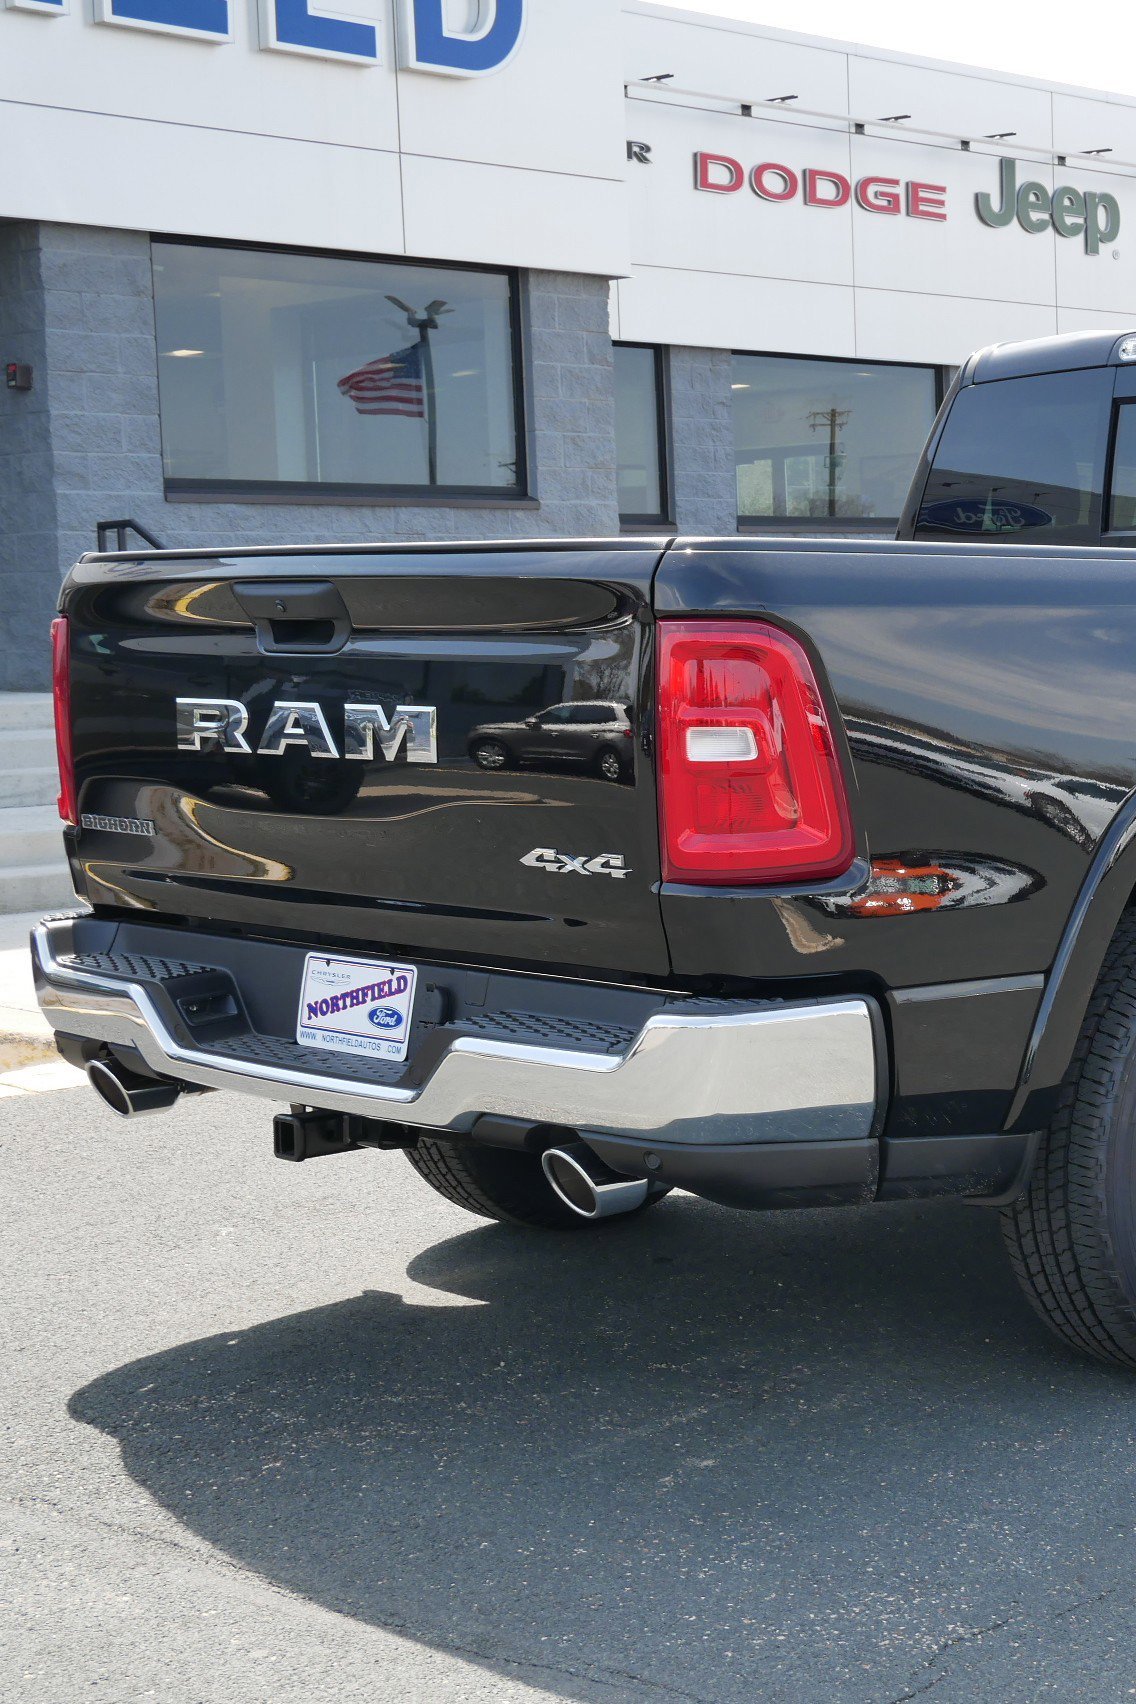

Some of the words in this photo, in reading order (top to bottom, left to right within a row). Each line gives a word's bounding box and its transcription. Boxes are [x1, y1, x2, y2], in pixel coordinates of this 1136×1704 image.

[692, 151, 948, 222] DODGE
[975, 158, 1120, 256] Jeep
[175, 697, 438, 764] RAM
[81, 814, 155, 837] BIGHORN
[312, 969, 351, 980] CHRYSLER
[306, 975, 408, 1020] NORTHFIELD
[373, 1007, 398, 1027] Ford
[321, 1034, 381, 1052] NORTHFIELDAUTOS
